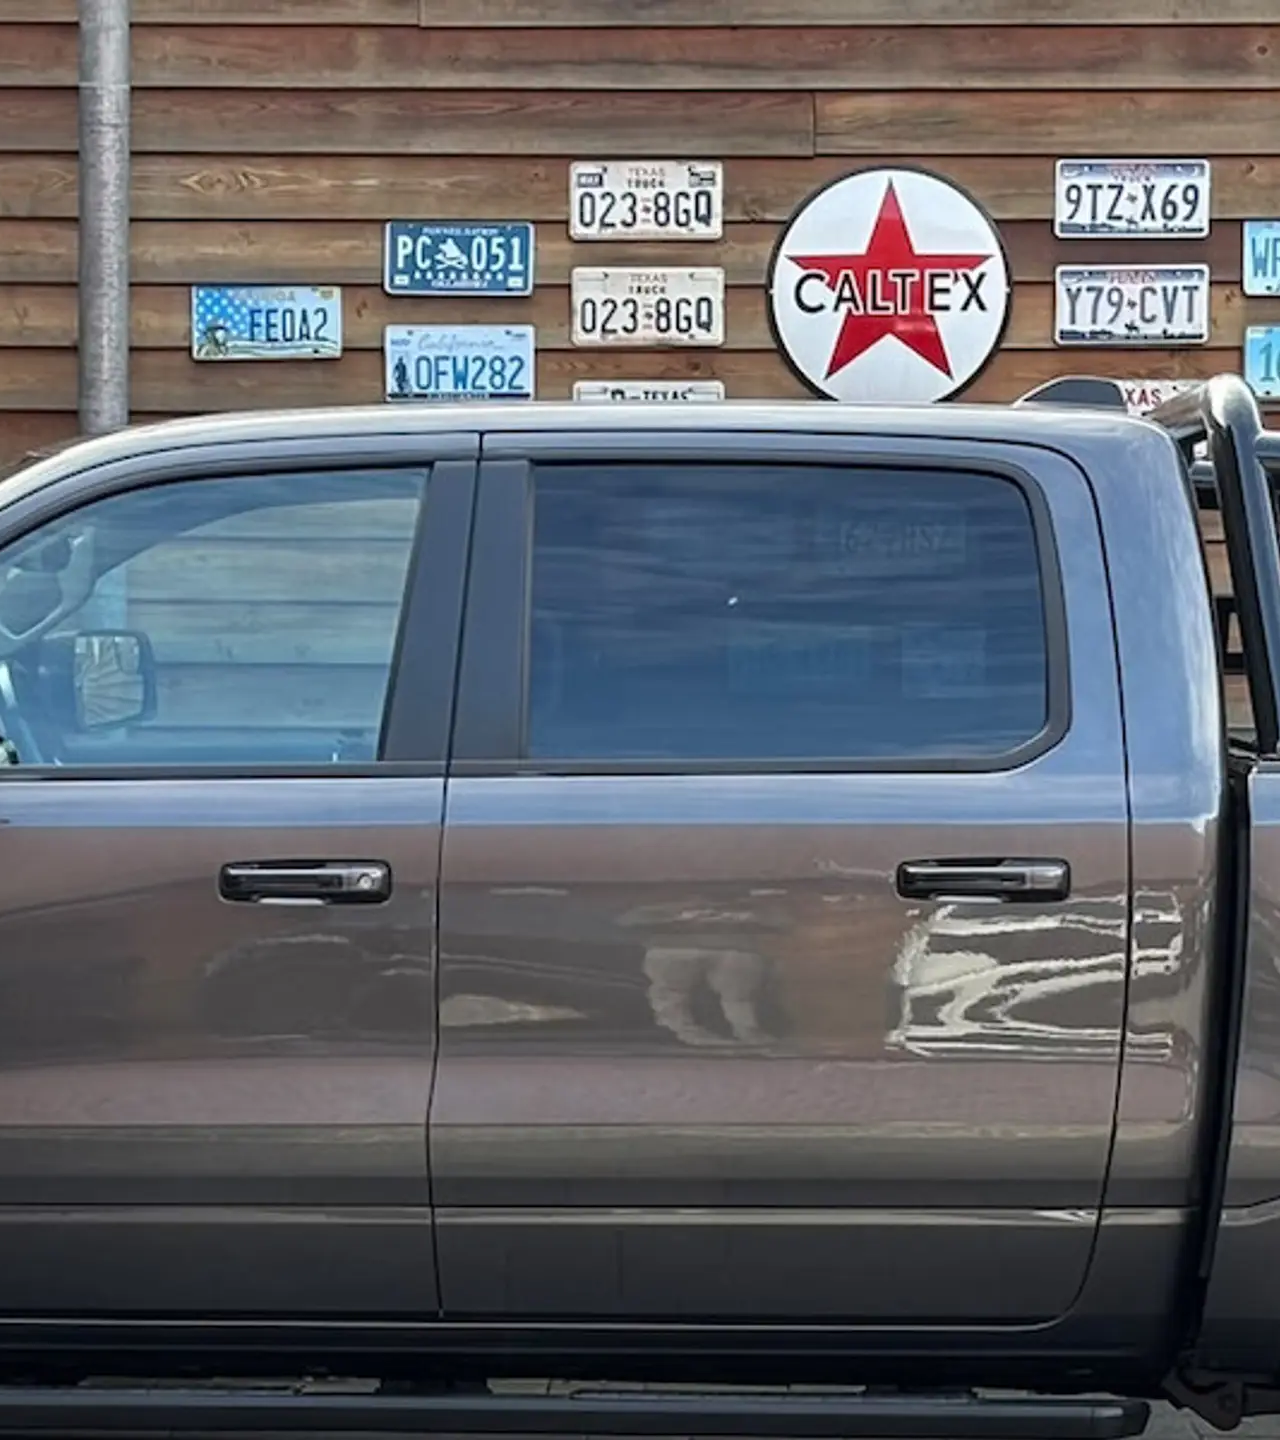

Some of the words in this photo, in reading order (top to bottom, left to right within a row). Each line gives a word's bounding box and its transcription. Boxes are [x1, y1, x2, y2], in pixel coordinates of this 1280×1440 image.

[579, 192, 637, 227] 023
[653, 190, 712, 227] 8GQ
[1065, 183, 1124, 221] 9TZ
[1140, 183, 1200, 221] X69
[396, 235, 432, 270] PC
[471, 235, 524, 271] 051
[793, 271, 988, 315] CALTEX
[1065, 286, 1124, 325] Y79
[1139, 285, 1200, 324] CVT
[581, 298, 638, 334] 023
[655, 296, 713, 334] 8GQ
[1125, 387, 1163, 408] XAS
